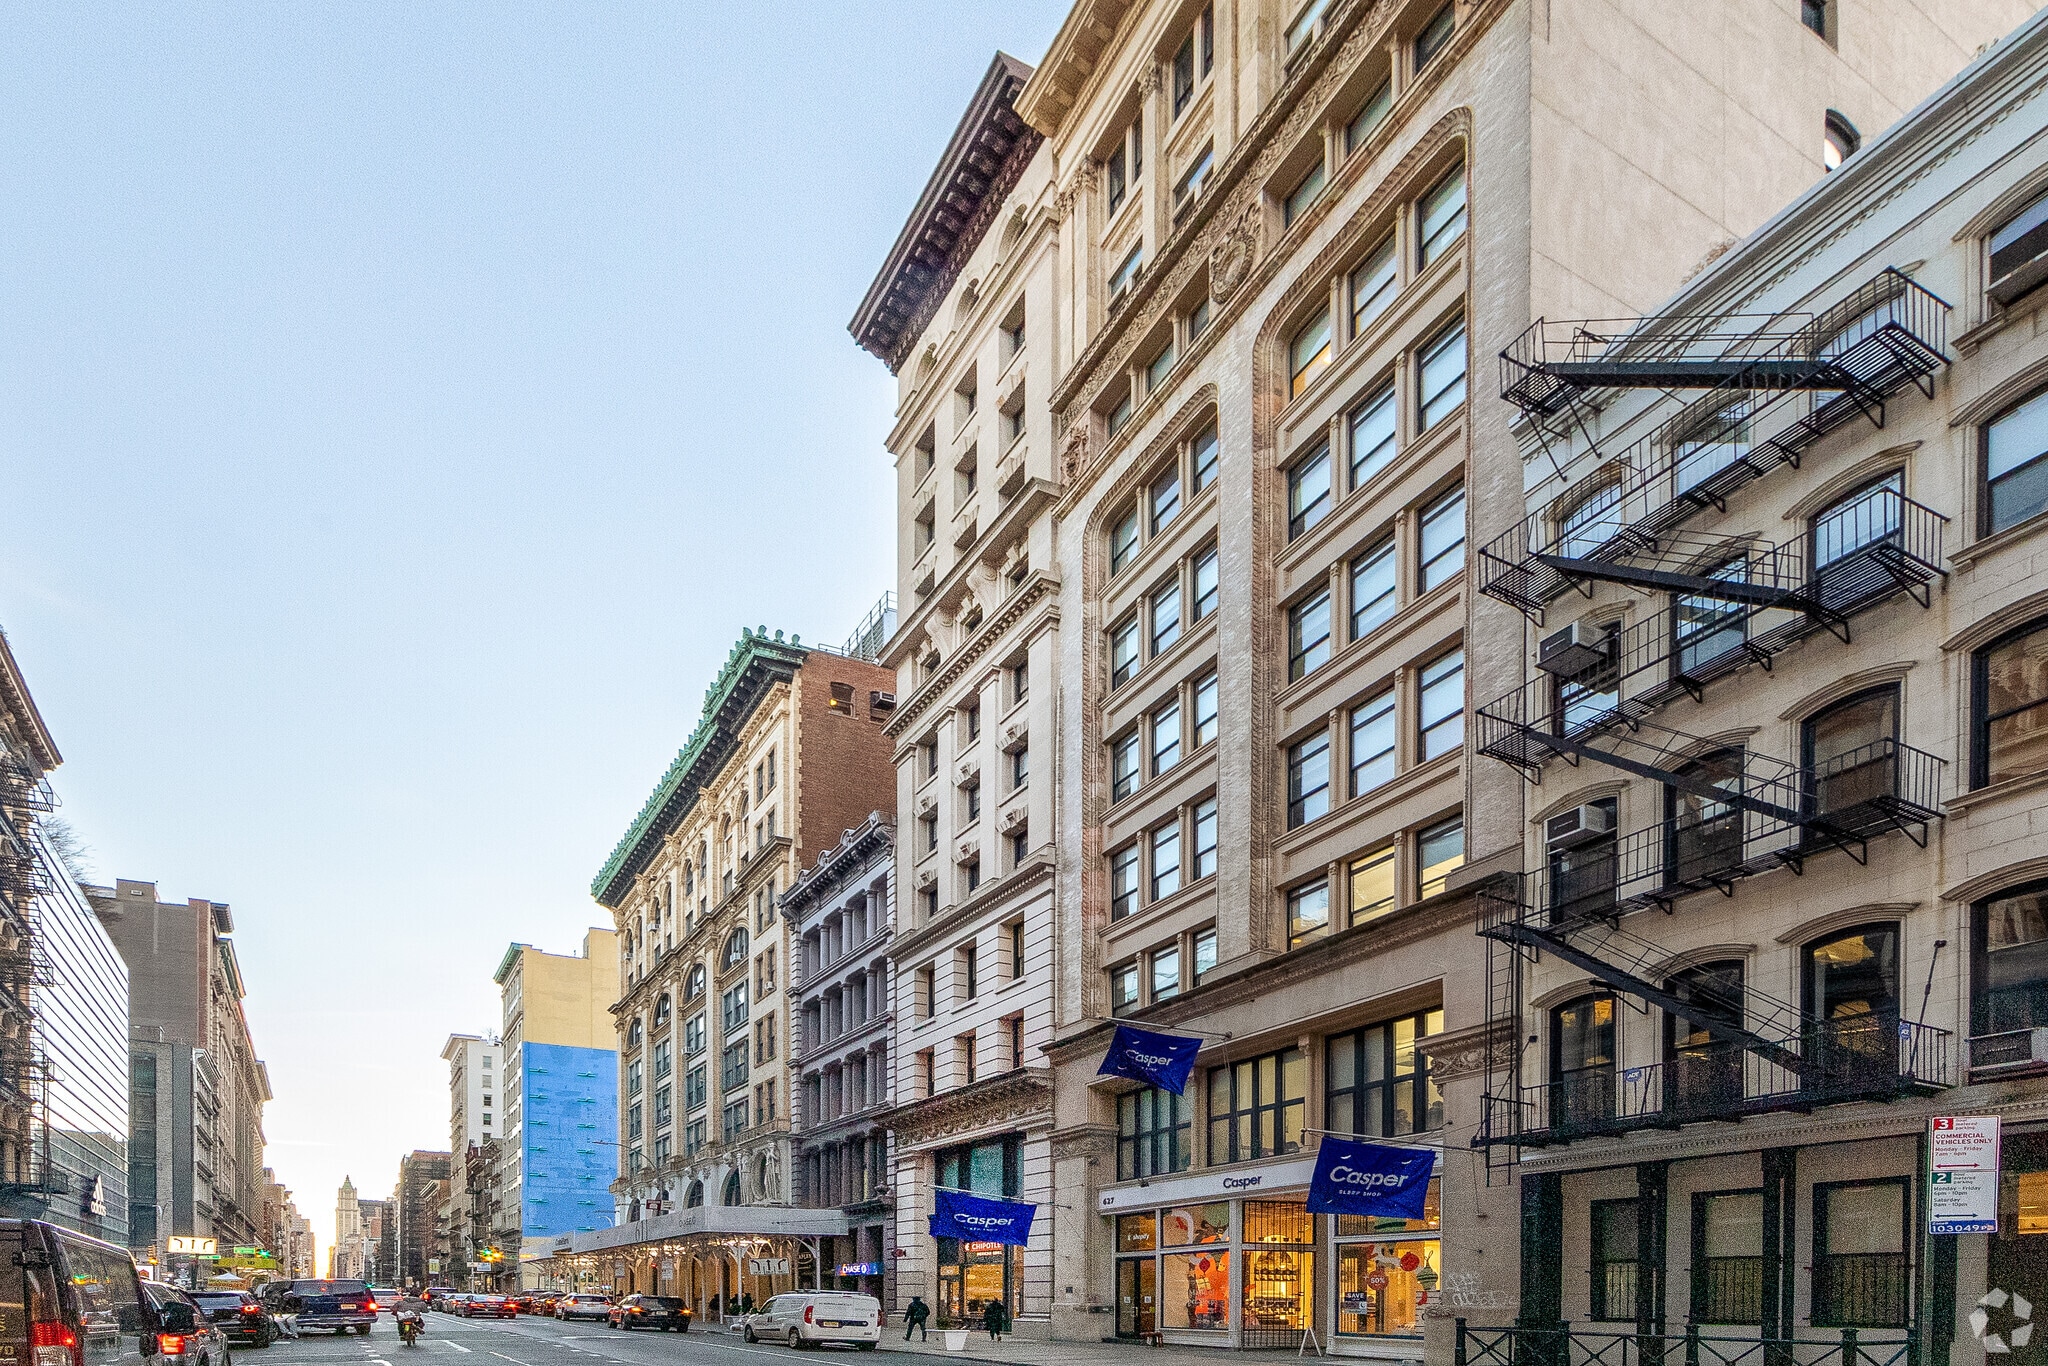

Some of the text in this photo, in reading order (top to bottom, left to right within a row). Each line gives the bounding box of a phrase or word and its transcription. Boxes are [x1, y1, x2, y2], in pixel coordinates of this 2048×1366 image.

[1126, 1050, 1174, 1066] Casper
[1938, 1119, 1949, 1129] 3
[1223, 1176, 1262, 1190] Casper
[1330, 1166, 1409, 1190] Casper
[1936, 1173, 1947, 1183] 2
[1102, 1197, 1114, 1206] 627
[91, 1201, 106, 1217] adidas
[954, 1214, 1015, 1228] Casper
[636, 1220, 647, 1241] 611
[972, 1242, 1001, 1250] CHIPOTLE
[842, 1265, 860, 1274] CHASE
